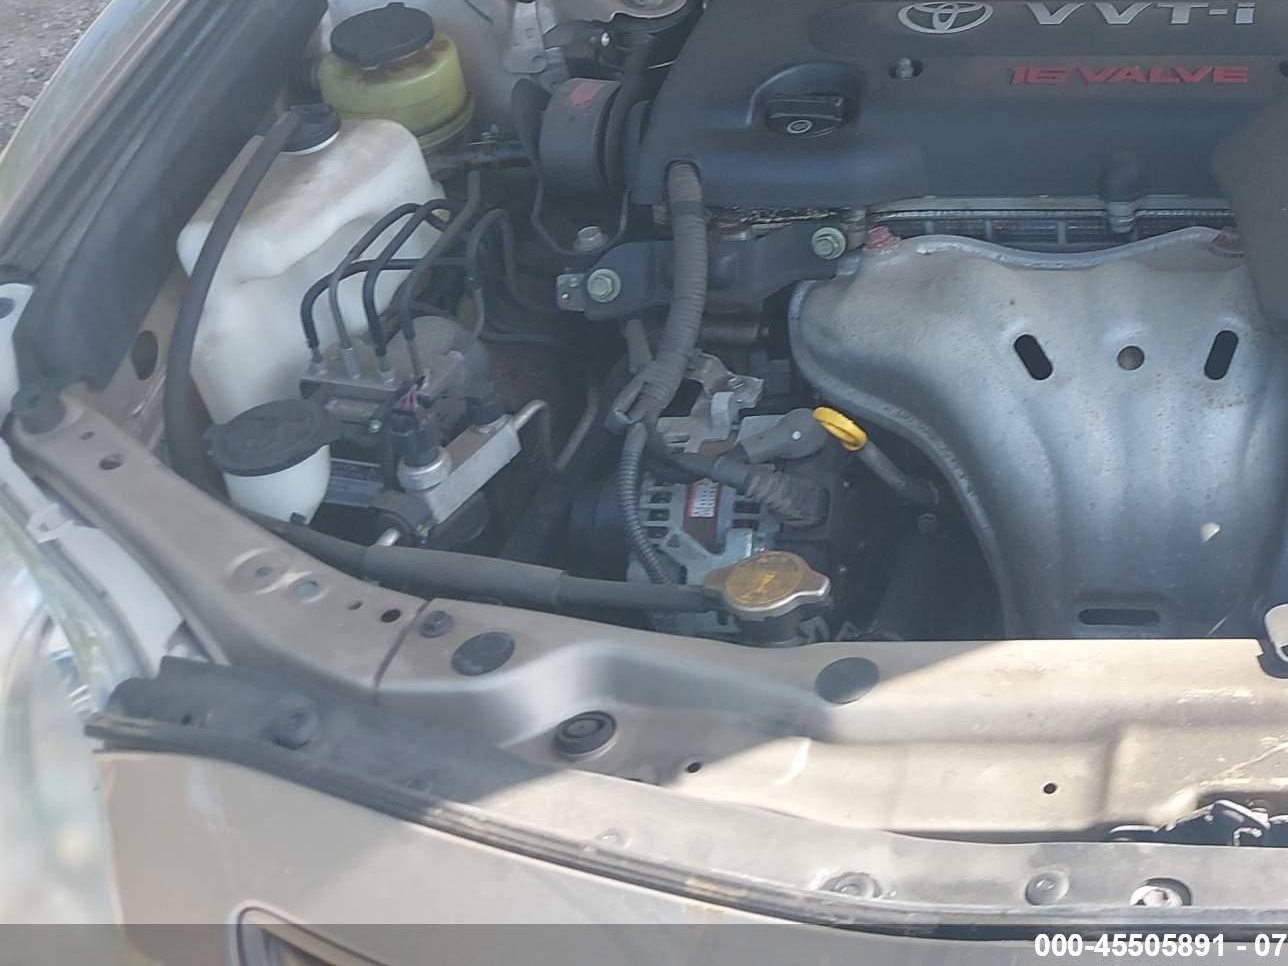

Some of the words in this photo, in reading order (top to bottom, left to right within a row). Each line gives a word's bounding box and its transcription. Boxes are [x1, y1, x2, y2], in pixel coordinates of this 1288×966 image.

[1027, 1, 1254, 25] VVT-i
[1011, 66, 1068, 84] 16
[1078, 66, 1249, 84] VALVE
